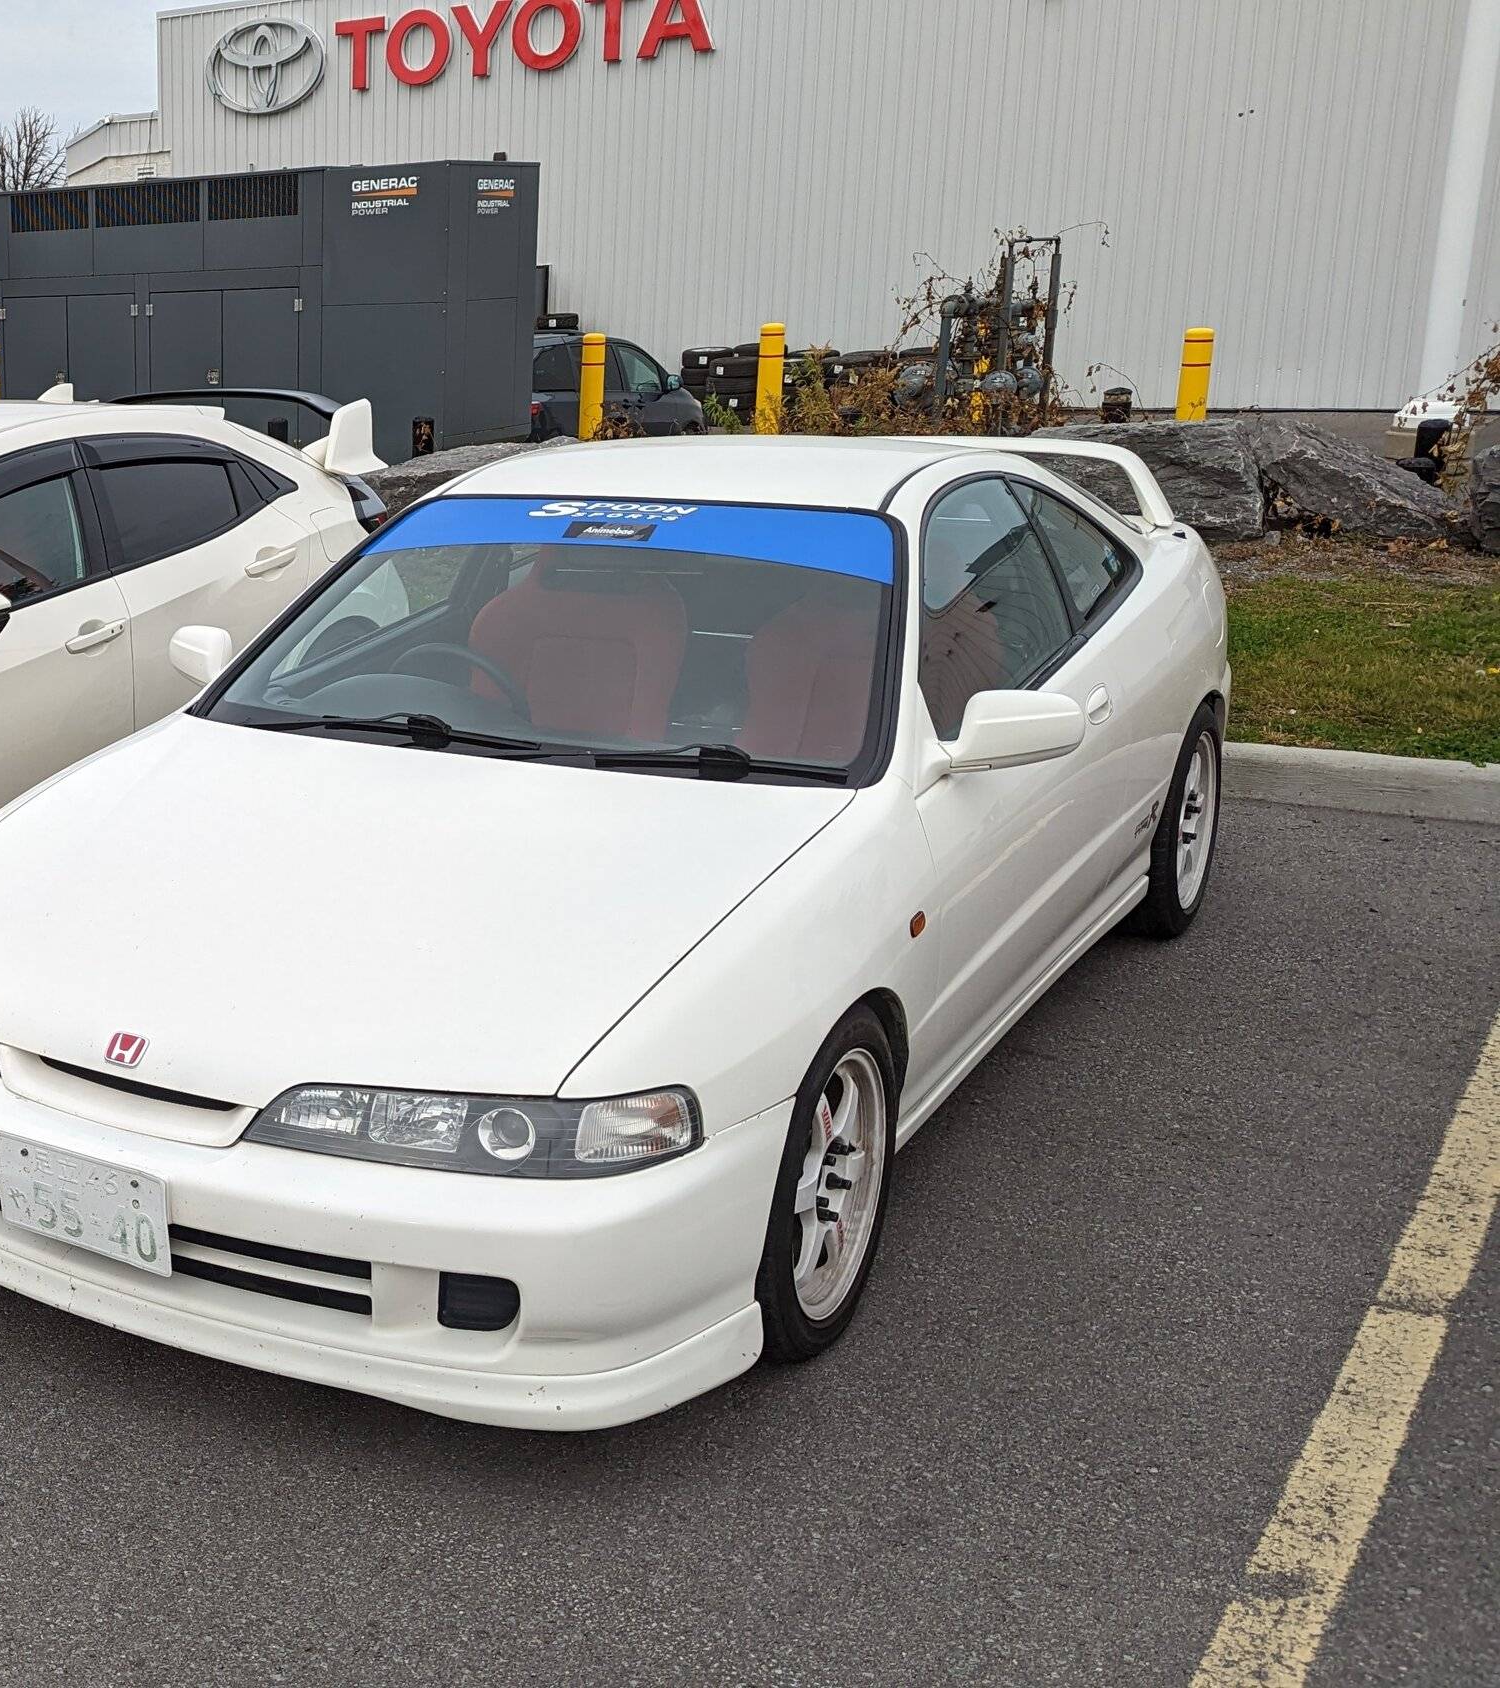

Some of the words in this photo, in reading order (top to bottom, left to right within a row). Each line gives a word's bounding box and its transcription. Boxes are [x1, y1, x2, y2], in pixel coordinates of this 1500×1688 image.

[335, 0, 714, 91] TOYOTA
[352, 176, 418, 192] GENERAC
[477, 178, 515, 190] GENERAC
[351, 198, 409, 209] INDUSTRIAL
[351, 207, 389, 216] POWER
[477, 207, 499, 215] POWER
[529, 501, 699, 517] SPOON
[570, 512, 680, 521] SPORTS
